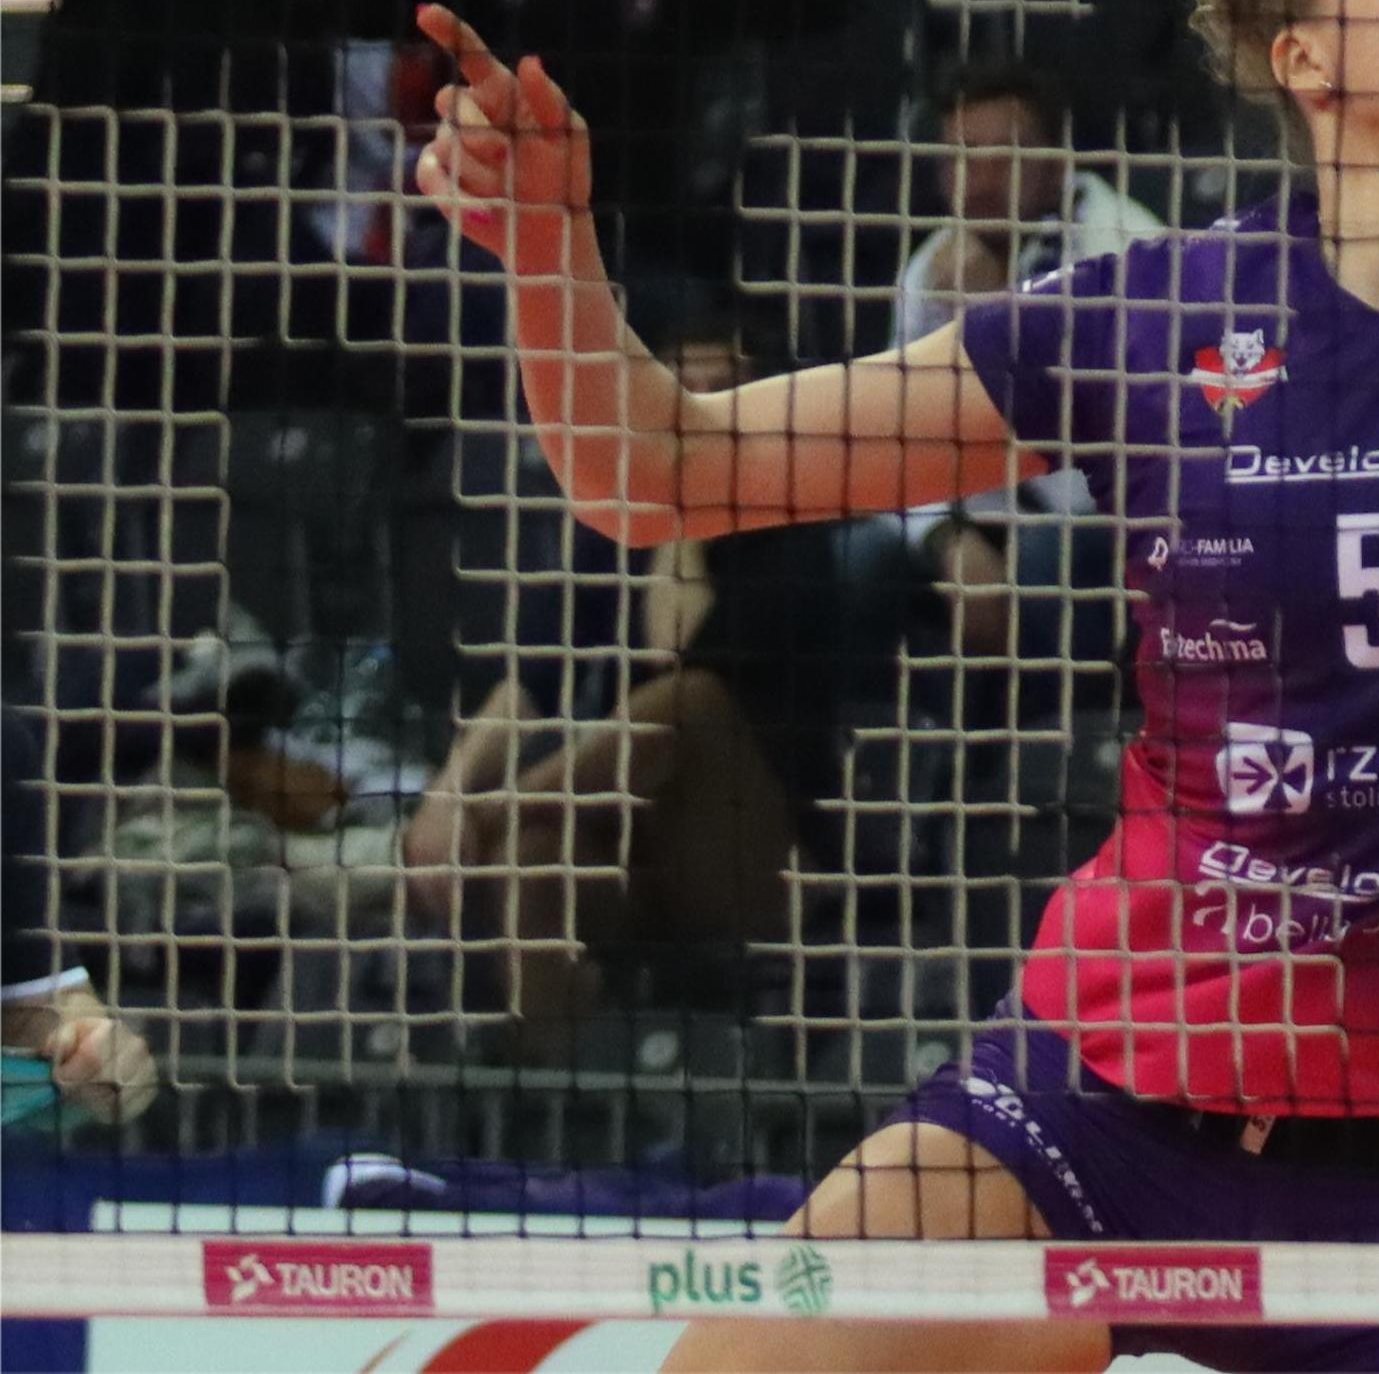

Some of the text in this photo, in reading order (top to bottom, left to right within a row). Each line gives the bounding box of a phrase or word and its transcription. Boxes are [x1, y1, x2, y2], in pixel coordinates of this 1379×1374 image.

[276, 1261, 413, 1300] TAURON
[648, 1250, 762, 1312] plus
[1111, 1265, 1243, 1302] TAURON
